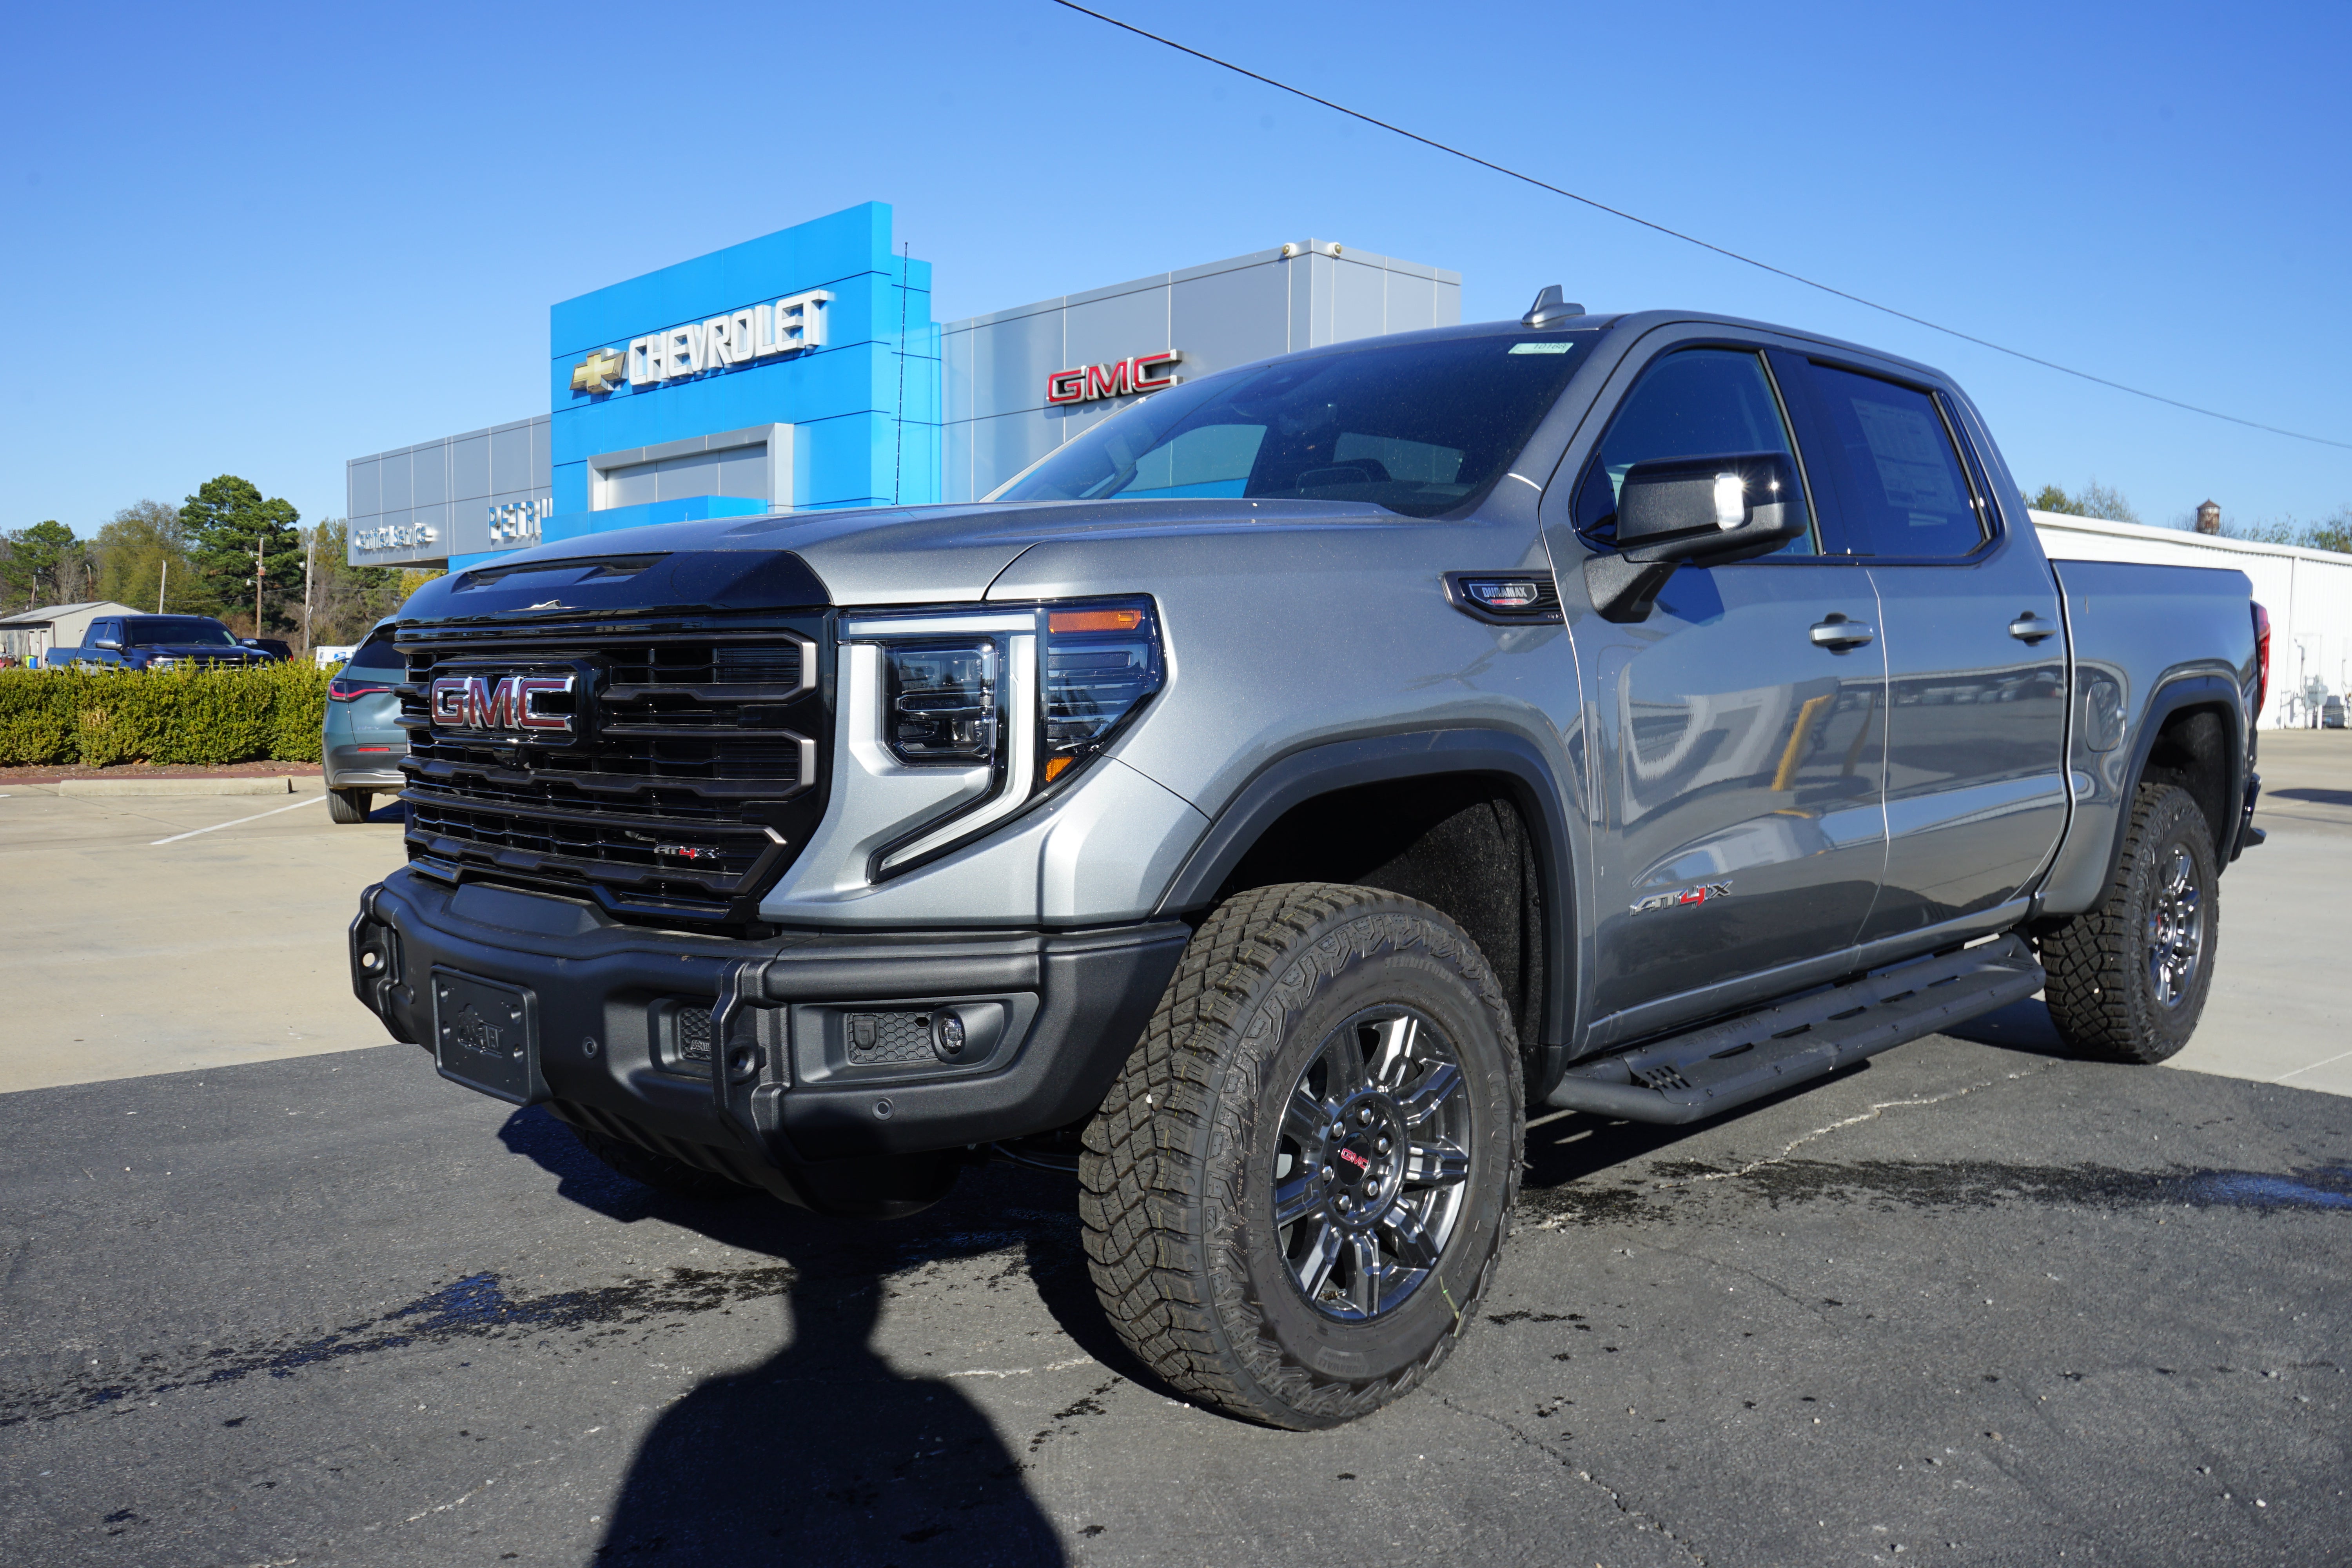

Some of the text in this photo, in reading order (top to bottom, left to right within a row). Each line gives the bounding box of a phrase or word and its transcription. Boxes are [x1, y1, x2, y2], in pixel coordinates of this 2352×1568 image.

[628, 289, 833, 386] CHEVROLET
[1047, 348, 1182, 406] GMC
[394, 523, 433, 546] Service
[1481, 586, 1528, 598] DURAMAX
[432, 677, 574, 733] GMC
[653, 844, 717, 860] AT4X
[1629, 879, 1733, 916] AT4X
[1385, 956, 1455, 984] TERRITORY
[1341, 1147, 1368, 1170] GMC
